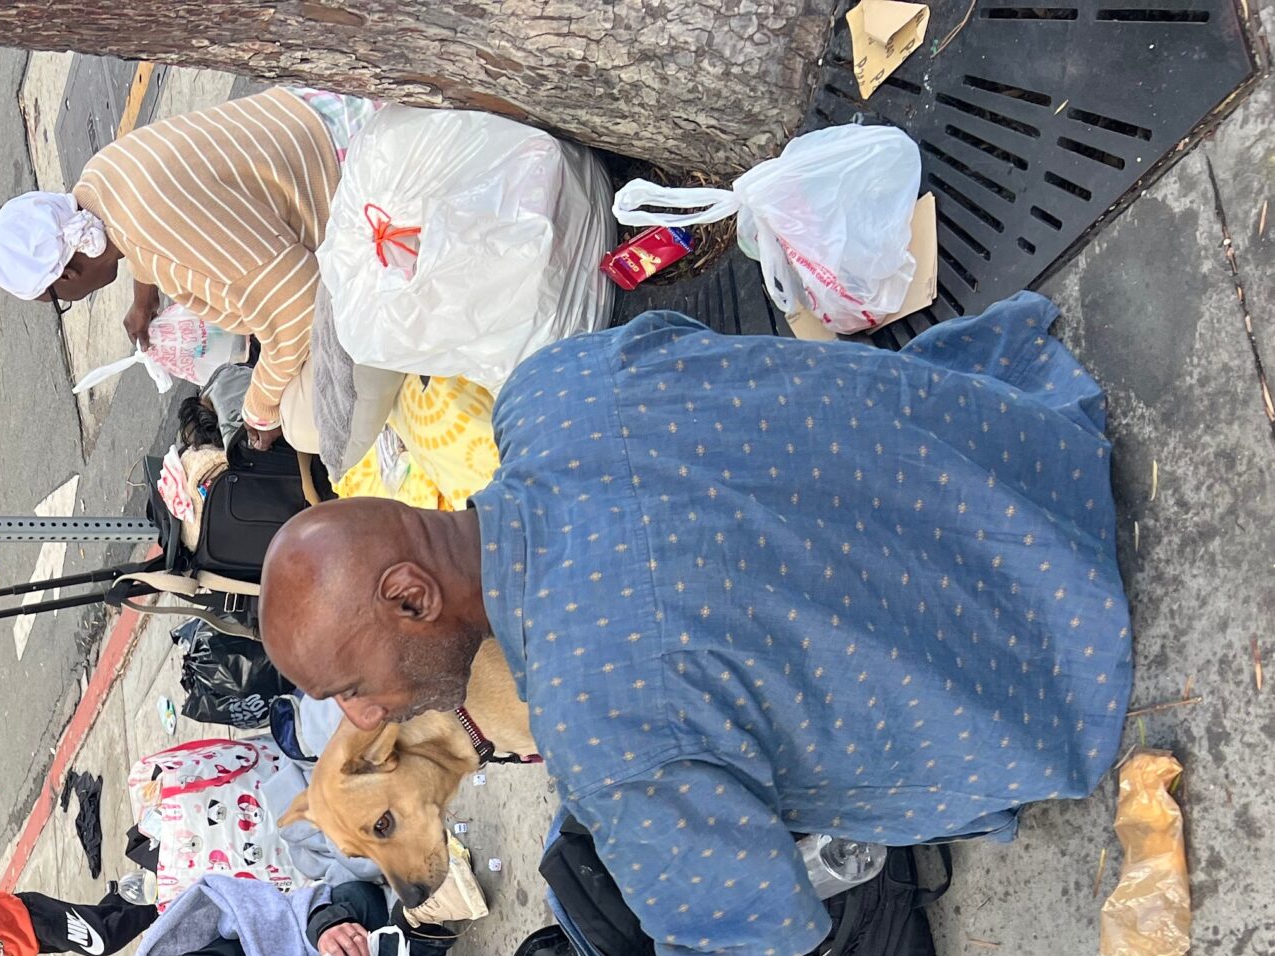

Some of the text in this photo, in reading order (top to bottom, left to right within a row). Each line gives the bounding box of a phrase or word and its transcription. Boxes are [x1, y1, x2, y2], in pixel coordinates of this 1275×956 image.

[621, 253, 640, 272] GOLD
[245, 694, 268, 718] YOU
[66, 911, 88, 947] NIKE
